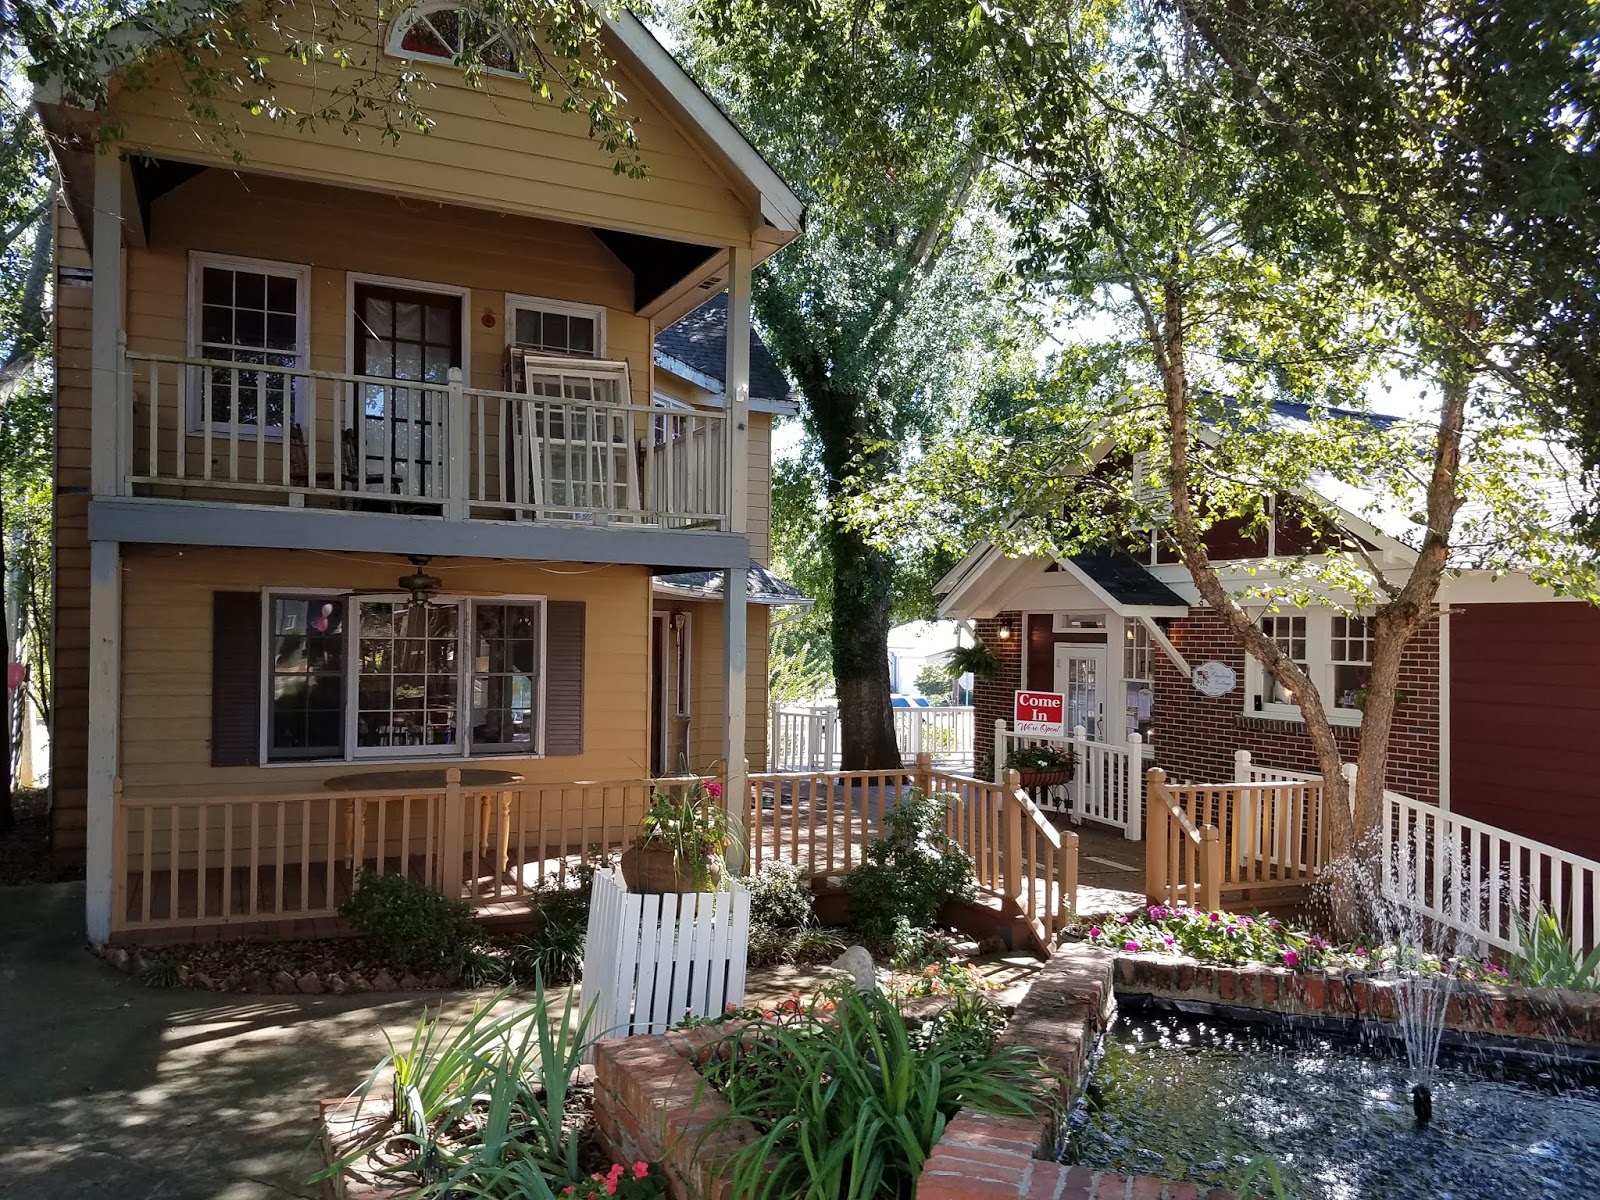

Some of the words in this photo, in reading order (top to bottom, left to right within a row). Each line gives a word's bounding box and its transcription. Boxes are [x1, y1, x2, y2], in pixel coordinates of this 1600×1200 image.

[1019, 694, 1060, 708] Come
[1031, 709, 1048, 721] In
[1040, 724, 1061, 734] Open!
